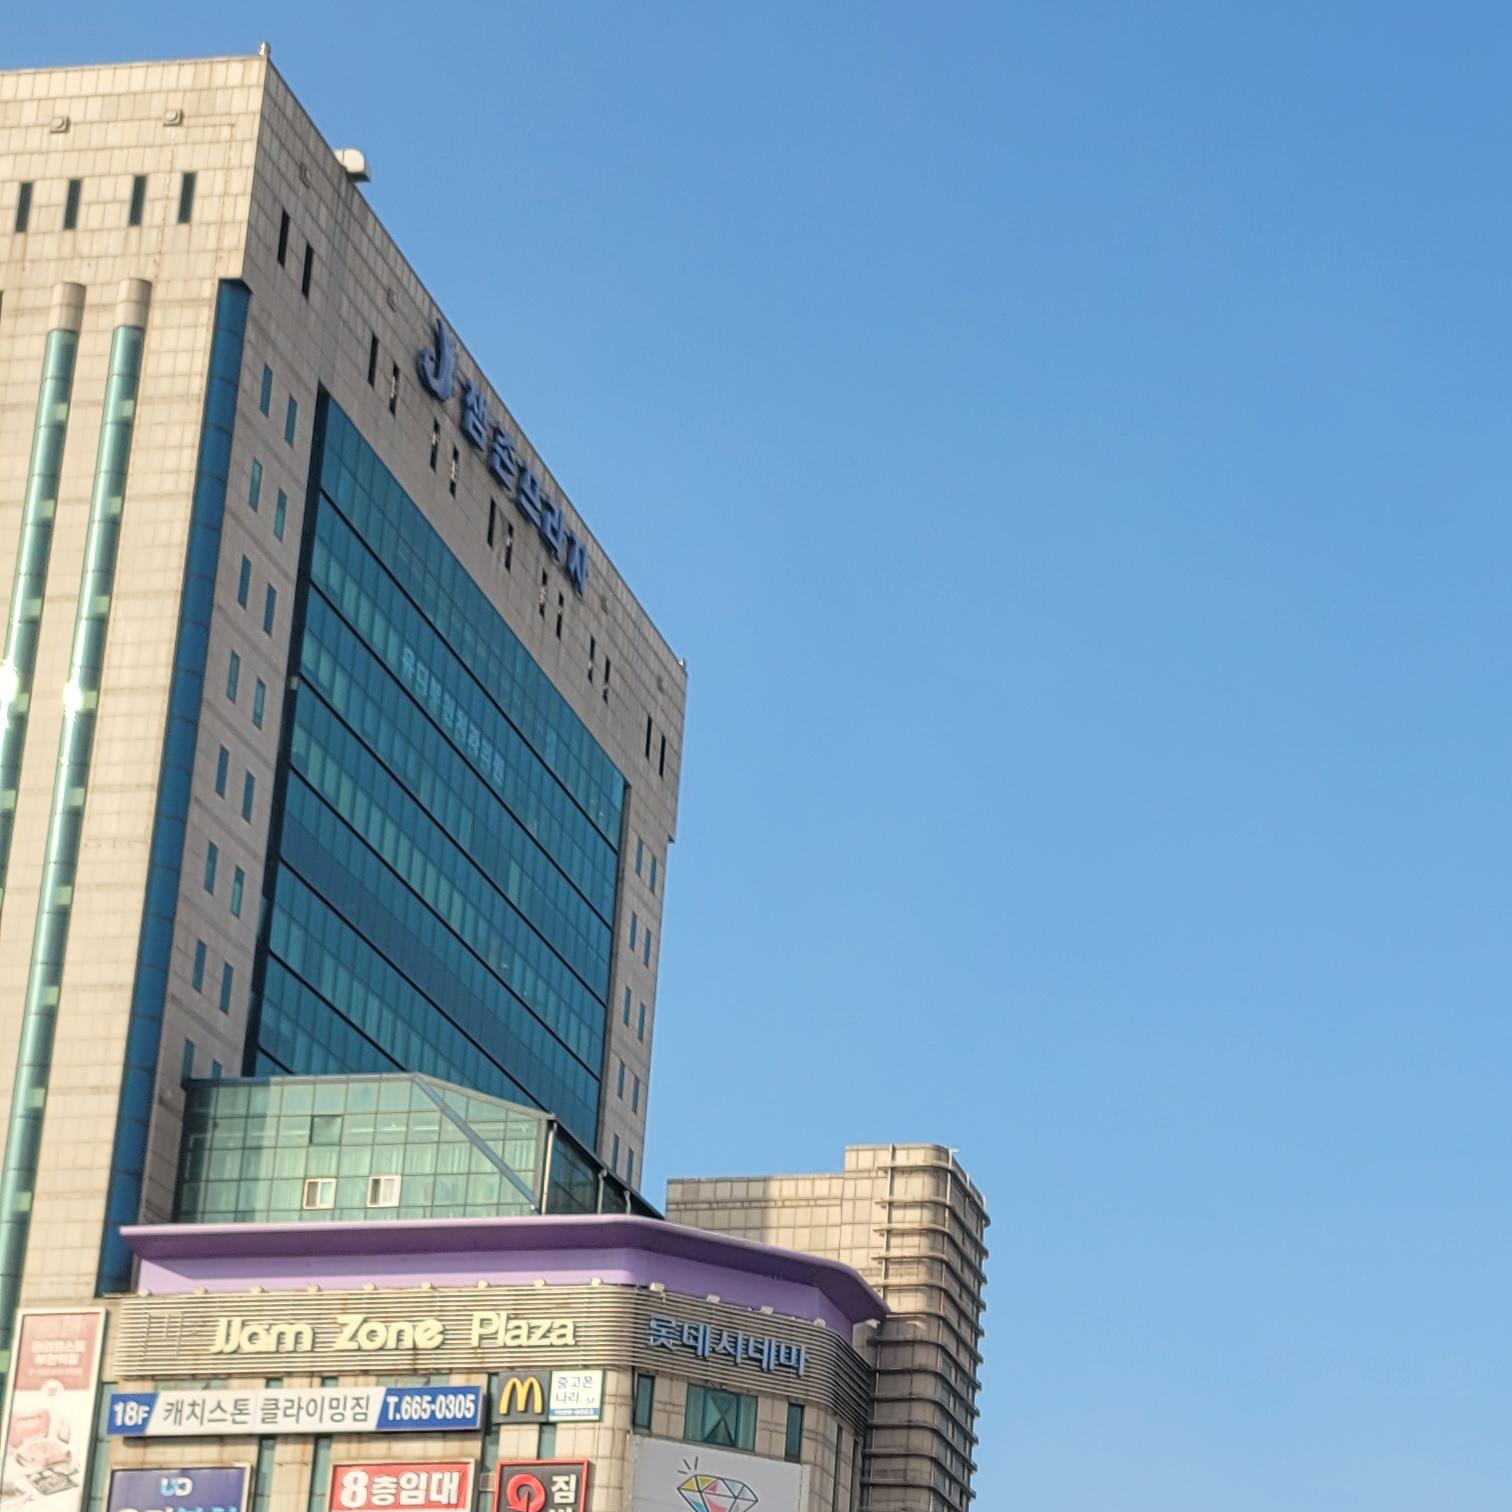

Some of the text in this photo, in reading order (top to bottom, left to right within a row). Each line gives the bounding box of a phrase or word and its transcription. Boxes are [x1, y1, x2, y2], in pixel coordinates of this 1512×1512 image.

[335, 1313, 447, 1352] Zone
[470, 1310, 577, 1348] Plaza
[648, 1313, 809, 1378] 롯데시네마
[111, 1392, 476, 1428] 18F 캐치스톤 클라이밍짐 T.665-0305
[340, 1471, 460, 1509] 8층임대
